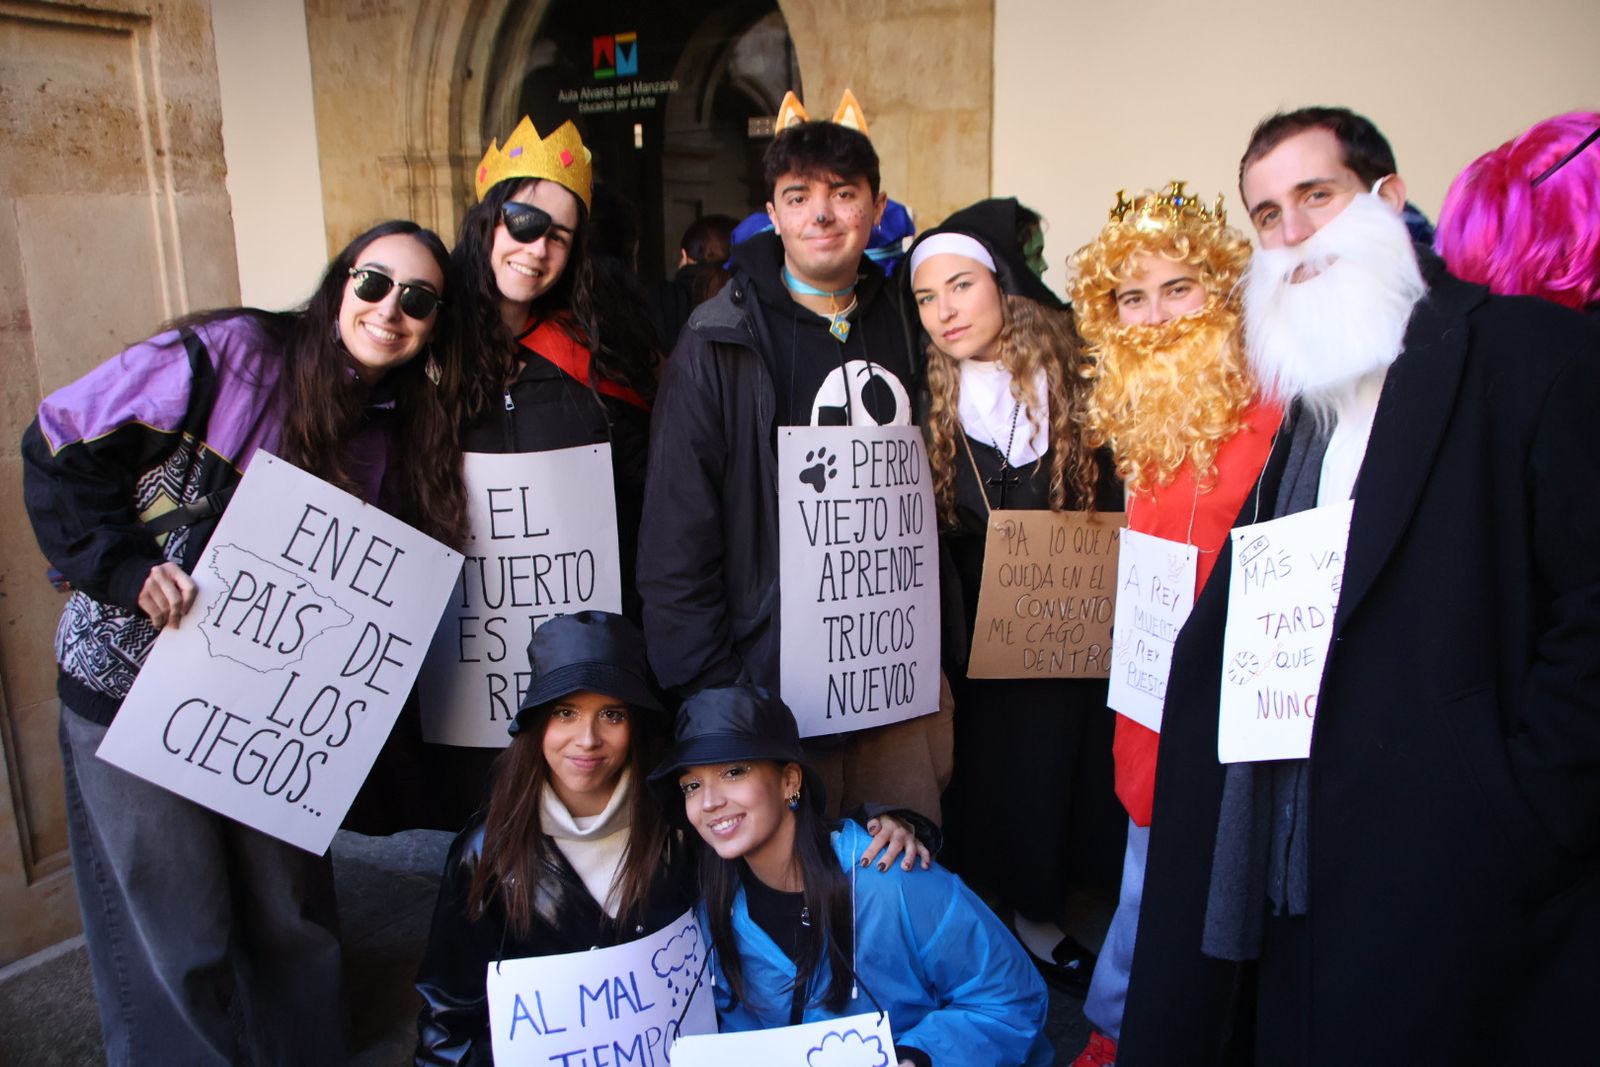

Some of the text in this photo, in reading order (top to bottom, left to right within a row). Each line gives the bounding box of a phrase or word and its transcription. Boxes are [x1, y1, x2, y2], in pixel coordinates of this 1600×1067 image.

[616, 82, 631, 97] del
[851, 439, 920, 489] PERRO
[798, 492, 923, 546] VIEJO NO
[1073, 527, 1101, 556] QUE
[281, 503, 405, 607] EN EL
[461, 549, 595, 610] TUERTO
[817, 545, 924, 603] APRENDE
[998, 563, 1105, 591] QUEDA EN EL
[1015, 593, 1113, 625] CONVENTO
[1124, 564, 1180, 613] A REY
[213, 570, 412, 695] PAÍS DE
[458, 616, 507, 663] ES
[823, 605, 915, 663] TRUCOS
[987, 617, 1085, 648] ME CAGO
[1275, 647, 1316, 669] QUE
[266, 671, 367, 748] LOS
[826, 661, 917, 719] NUEVOS
[162, 698, 328, 817] CIEGOS...
[509, 971, 656, 1041] AL MAL
